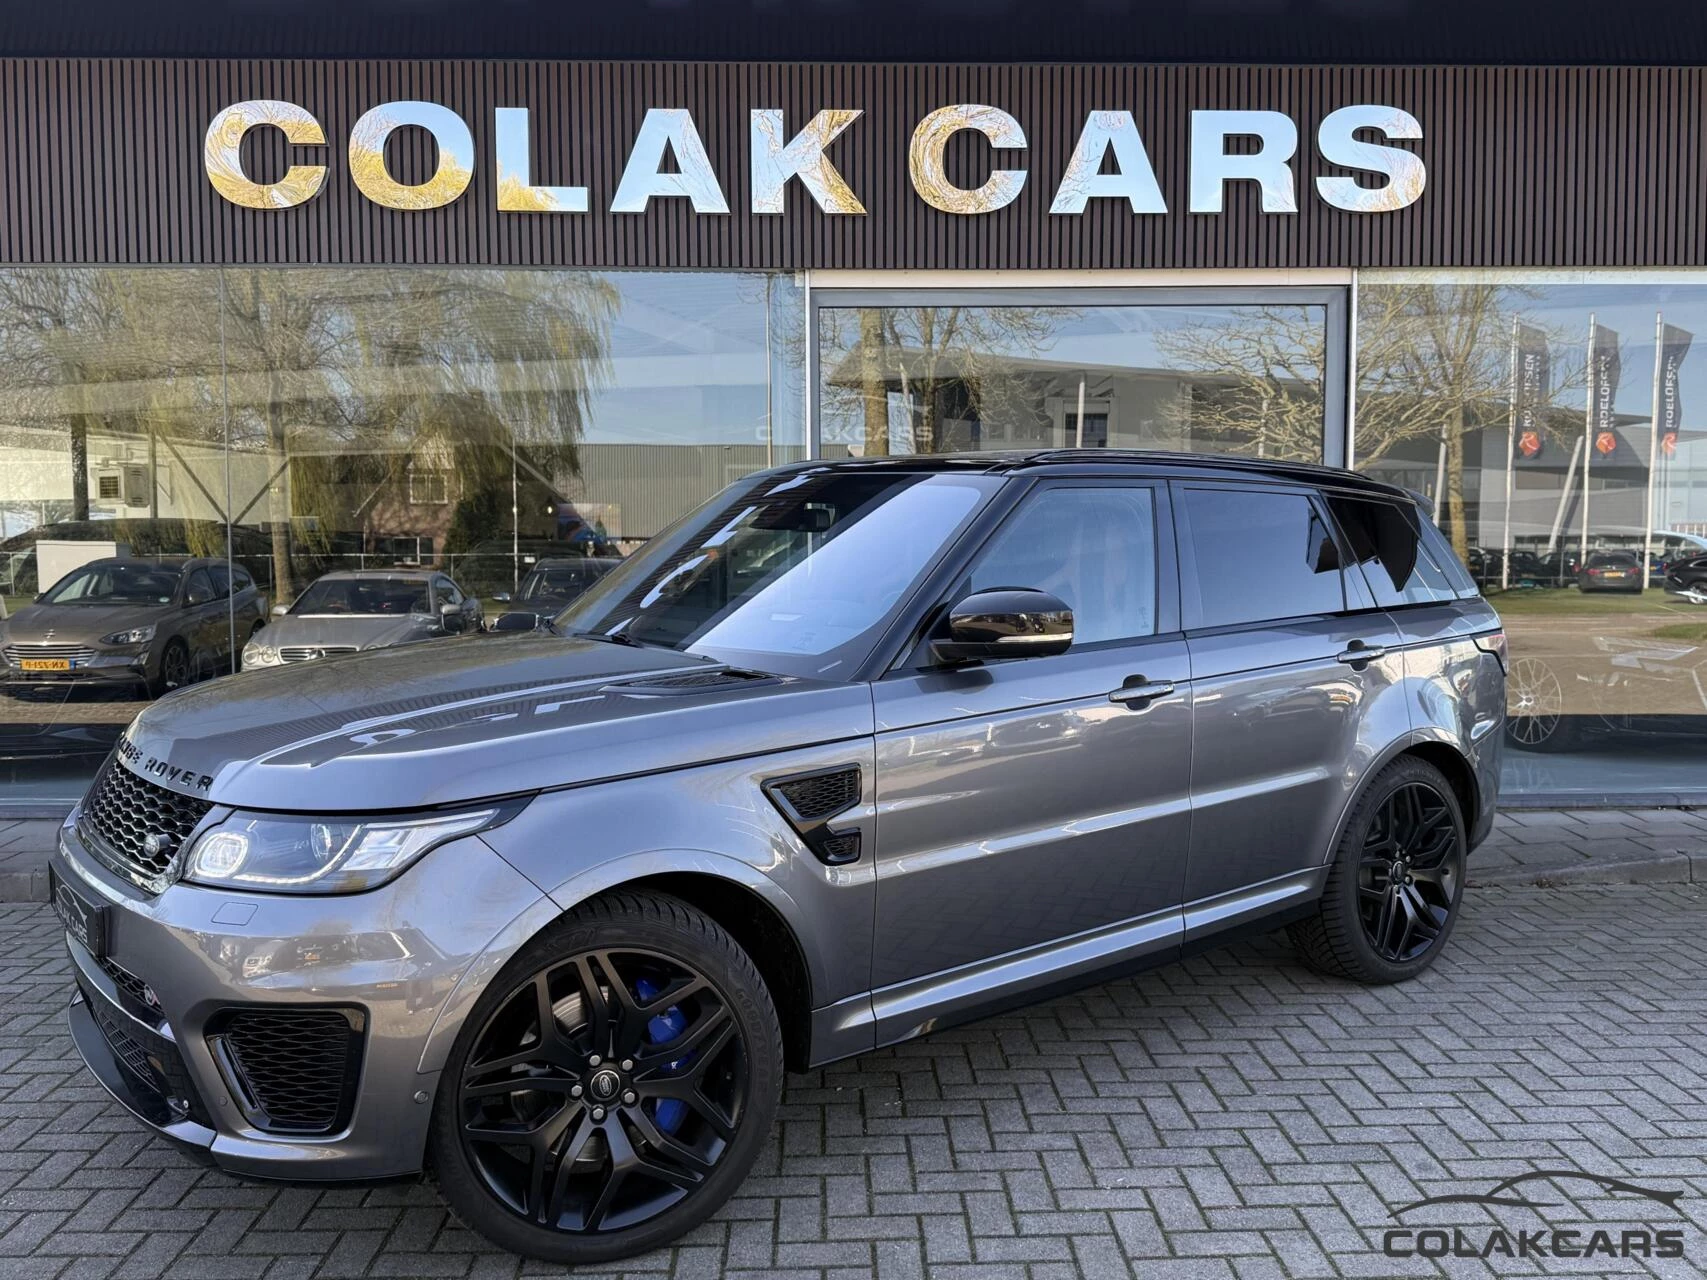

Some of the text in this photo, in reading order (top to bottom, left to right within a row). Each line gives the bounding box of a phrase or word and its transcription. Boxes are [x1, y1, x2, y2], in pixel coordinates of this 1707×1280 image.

[204, 100, 1427, 215] COLAK CARS
[1599, 355, 1610, 428] ROELOFS
[144, 757, 214, 791] ROVER
